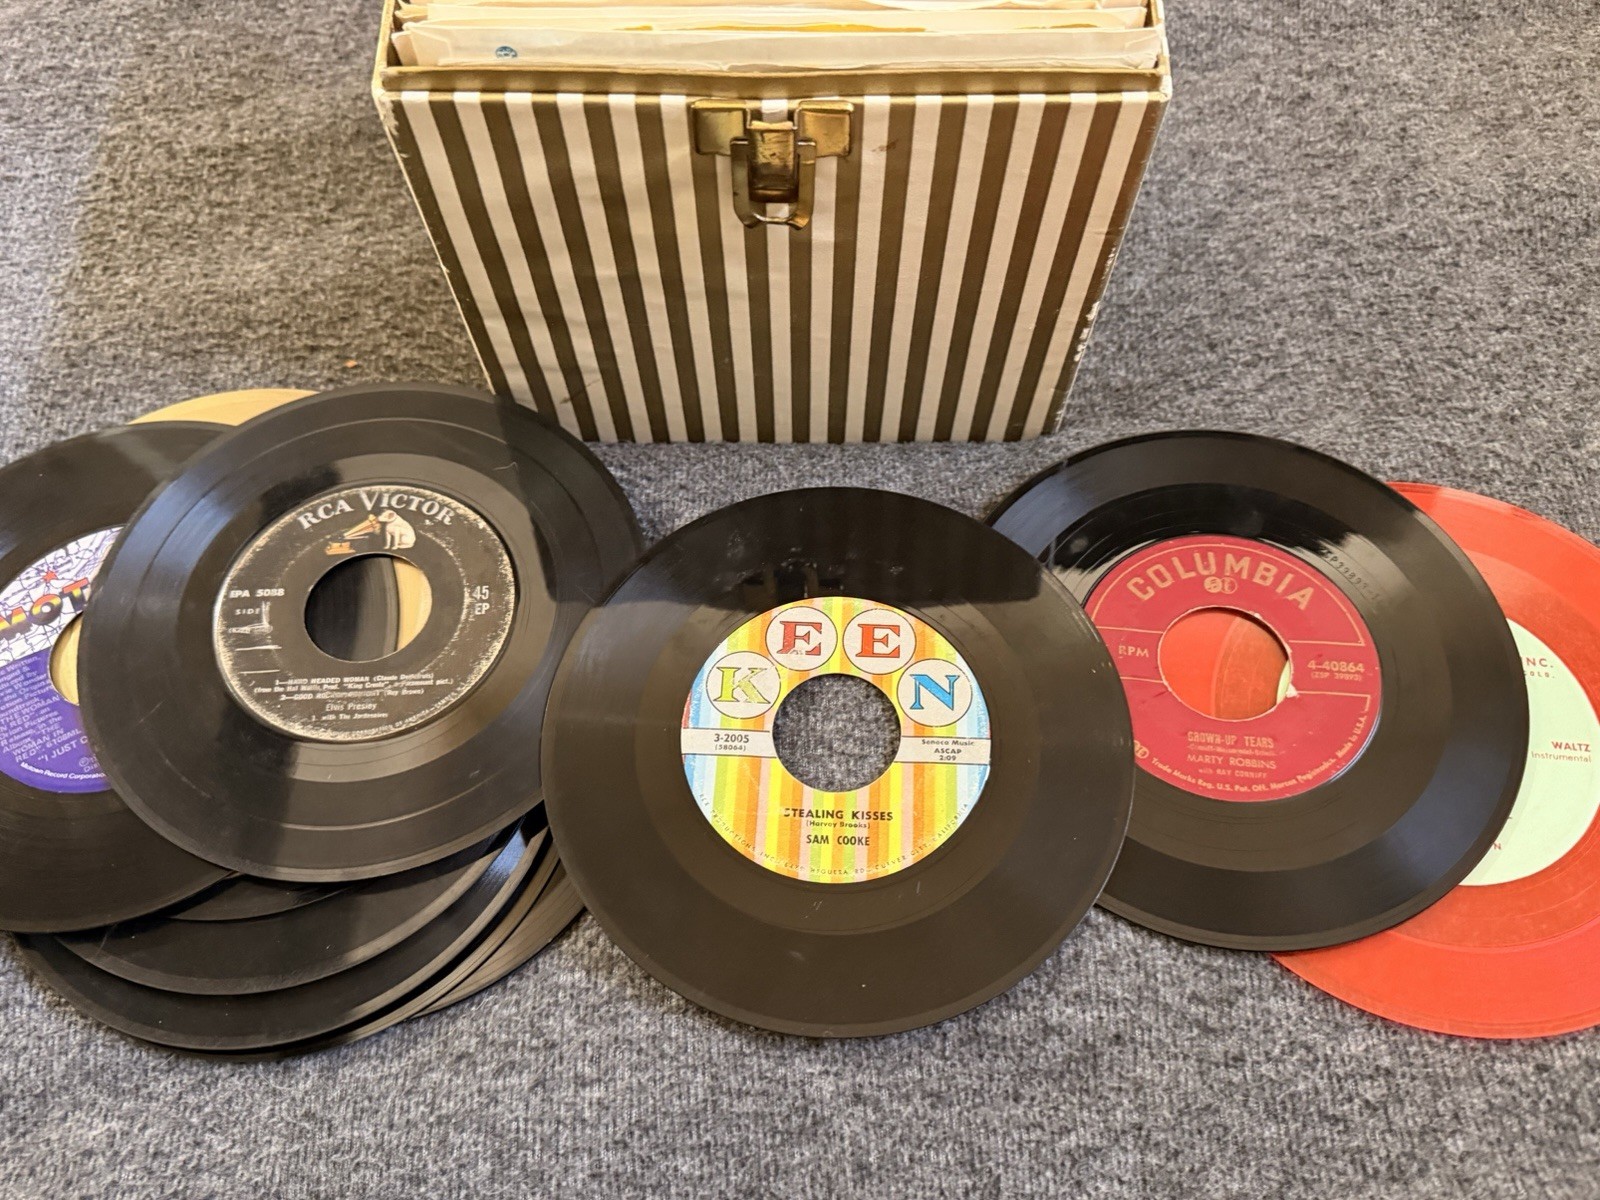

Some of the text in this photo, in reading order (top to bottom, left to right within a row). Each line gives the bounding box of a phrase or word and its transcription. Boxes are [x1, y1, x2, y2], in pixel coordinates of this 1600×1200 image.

[297, 490, 455, 529] RCA VICTOR
[1126, 551, 1314, 610] COLUMBIA
[229, 589, 251, 598] EPA
[472, 585, 489, 600] 45
[475, 602, 490, 615] EP
[1118, 645, 1149, 658] RPM
[1307, 660, 1365, 673] 4-40864
[1521, 657, 1554, 668] NC.
[21, 694, 59, 715] WOMAN
[325, 702, 377, 711] Elvis Presley
[12, 728, 64, 755] WOMAN IN
[714, 733, 750, 743] 3-2005
[1243, 736, 1274, 748] TEARS
[49, 740, 78, 758] JUST
[1551, 741, 1591, 752] WALTZ
[1187, 754, 1277, 770] MARTY ROBBINS
[1531, 751, 1592, 763] Instrumental
[44, 769, 68, 779] Record
[1151, 757, 1173, 774] Trade
[1172, 769, 1197, 783] Marks
[1216, 783, 1233, 791] U.S.
[1234, 784, 1251, 792] Pat.
[783, 808, 893, 821] STEALING KISSES
[806, 820, 871, 829] (Harvey Brooks)
[806, 834, 870, 846] SAM COOKE
